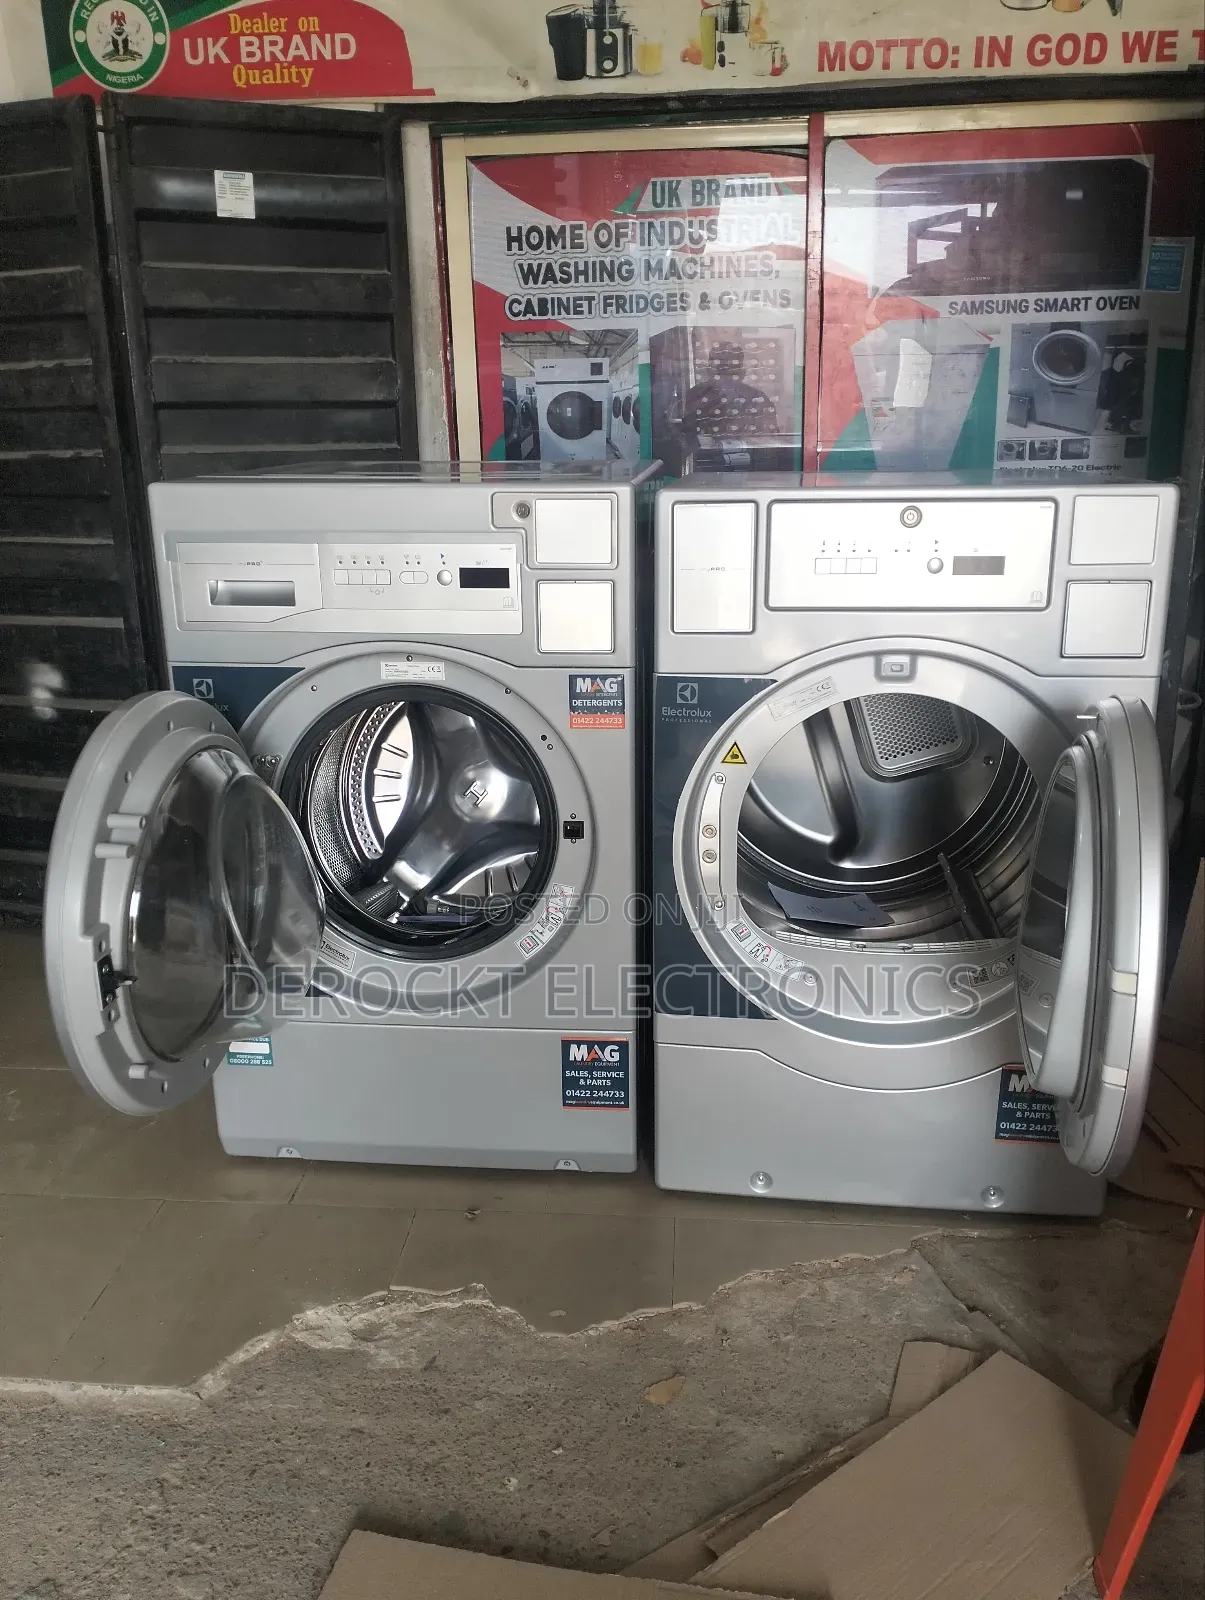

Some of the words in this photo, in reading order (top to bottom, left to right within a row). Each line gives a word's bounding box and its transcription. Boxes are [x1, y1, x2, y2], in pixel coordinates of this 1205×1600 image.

[229, 12, 288, 34] Dealer
[298, 16, 320, 32] on
[183, 37, 231, 65] UK
[239, 33, 357, 63] BRAND
[817, 36, 960, 72] MOTTO:
[974, 35, 1014, 68] IN
[1027, 32, 1108, 67] GOD
[1122, 30, 1179, 63] WE
[105, 73, 144, 84] NIGERIA
[232, 63, 314, 88] Quality
[651, 179, 682, 208] UK
[691, 176, 772, 206] BRAND
[506, 223, 585, 252] HOME
[594, 221, 630, 249] OF
[639, 216, 798, 248] INDUSTRIAL
[518, 259, 635, 285] WASHING
[643, 253, 780, 281] MACHINES,
[508, 295, 596, 317] CABINET
[603, 291, 691, 314] FRIDGES
[699, 291, 712, 311] &
[718, 288, 792, 310] OVENS
[948, 299, 1030, 316] SAMSUNG
[1033, 297, 1092, 313] SMART
[1095, 295, 1141, 311] OVEN
[576, 677, 618, 692] MAG
[572, 699, 623, 707] DETERGENTS
[661, 706, 712, 718] Electrolux
[569, 1043, 620, 1062] MAG
[565, 1070, 591, 1078] SALES,
[565, 1089, 591, 1097] 01422
[592, 1090, 625, 1098] 244733
[1001, 1101, 1030, 1110] SALES,
[1024, 1112, 1051, 1120] PARTS
[1000, 1121, 1027, 1131] 01422
